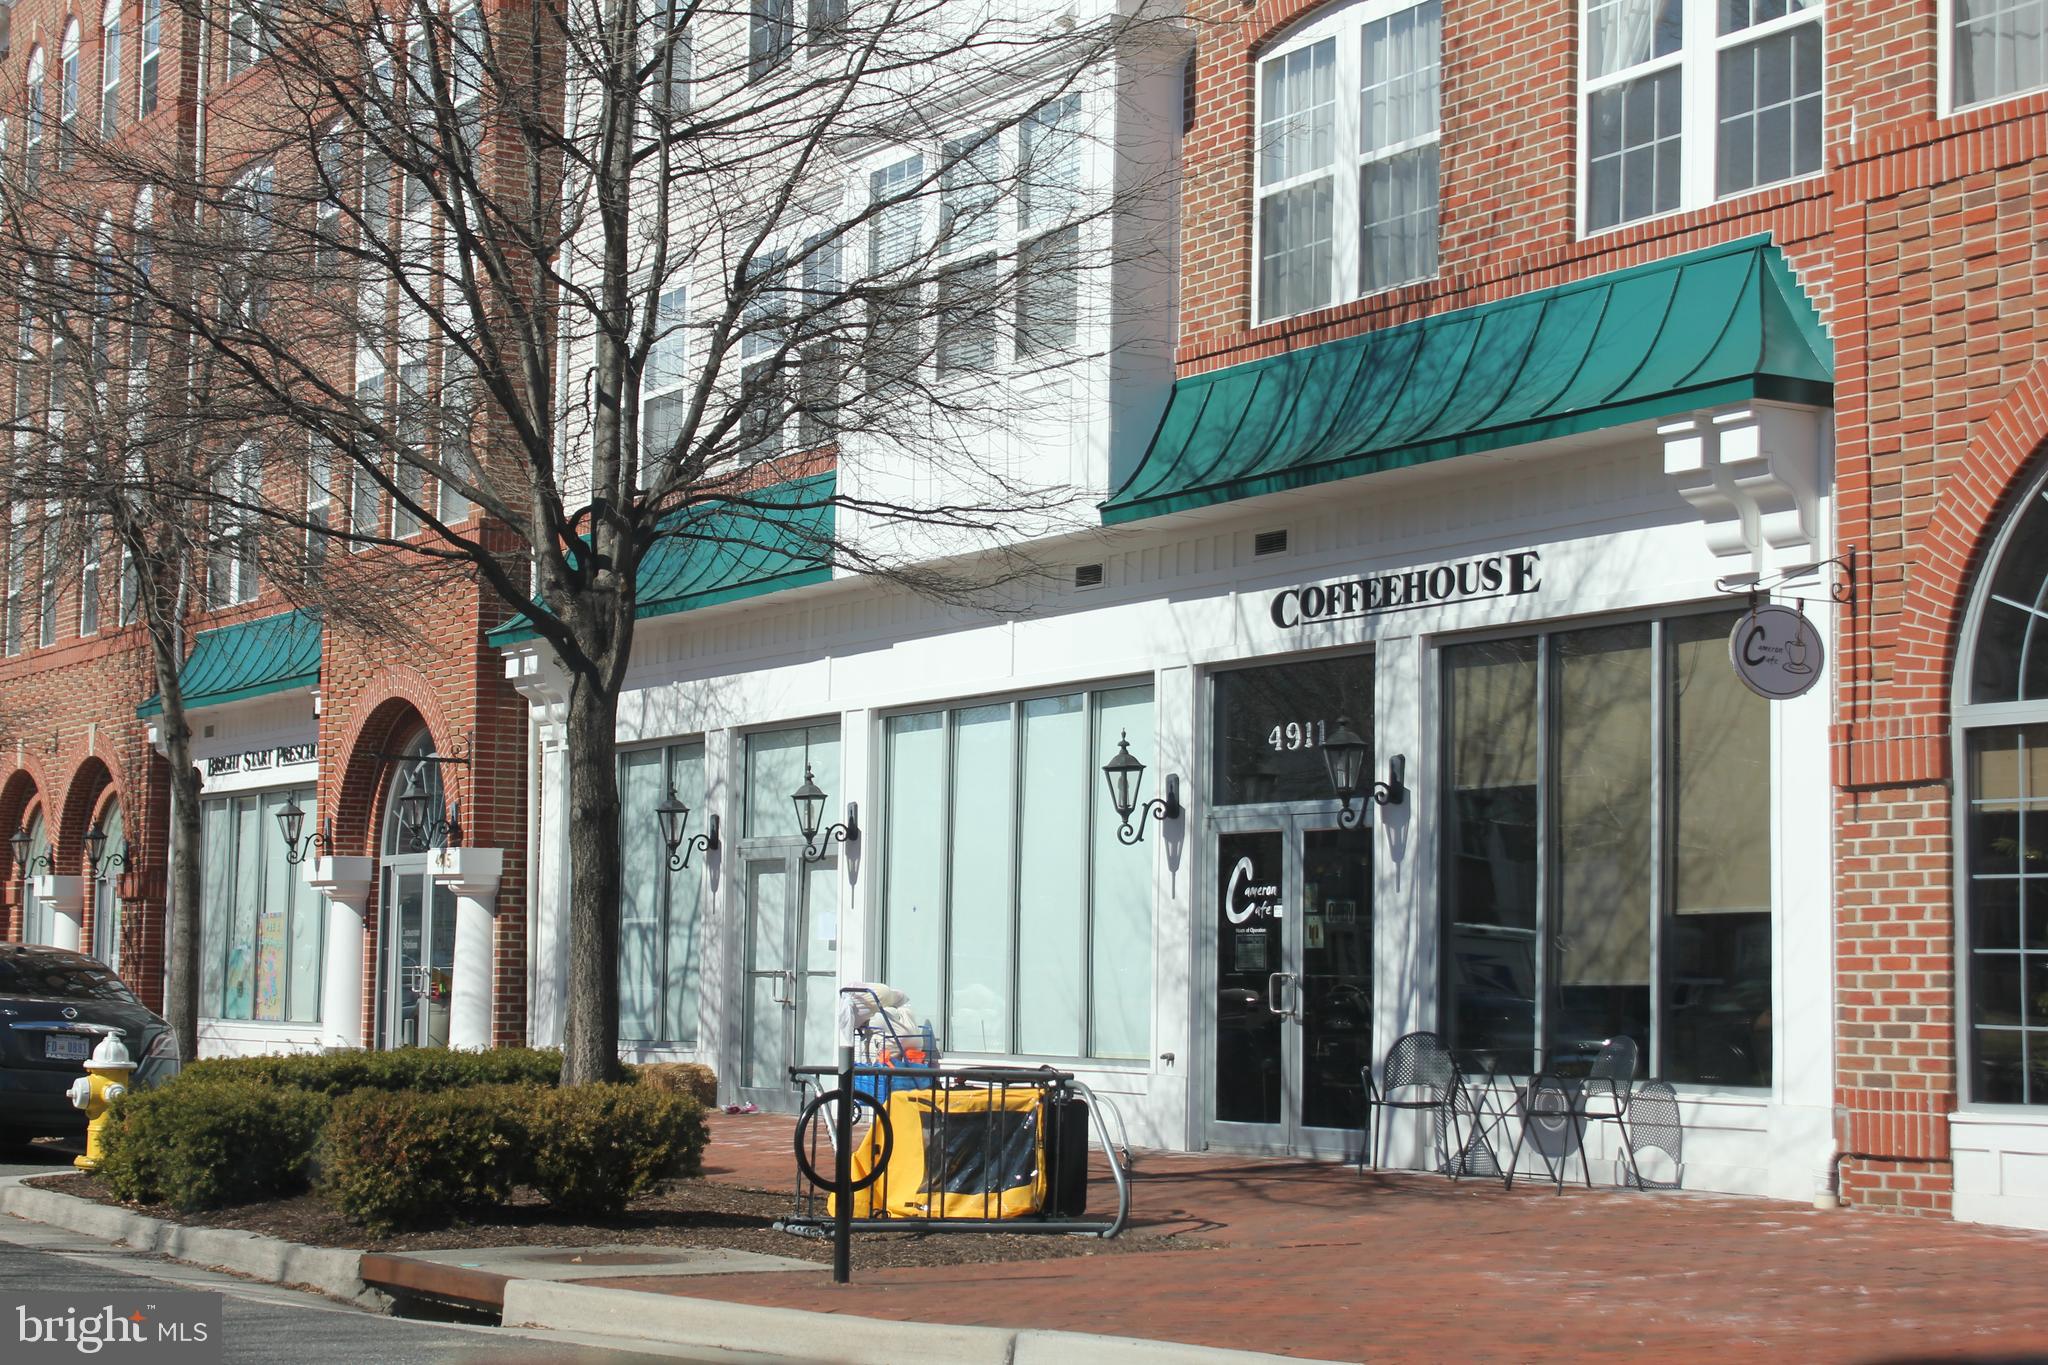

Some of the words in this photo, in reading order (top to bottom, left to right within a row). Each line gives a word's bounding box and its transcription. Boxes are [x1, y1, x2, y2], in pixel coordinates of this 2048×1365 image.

[1270, 551, 1542, 629] COFFEEHOUSE
[1268, 719, 1326, 751] 4911
[207, 753, 241, 777] BRIGHT
[243, 750, 274, 772] START
[1225, 856, 1278, 924] Cameron
